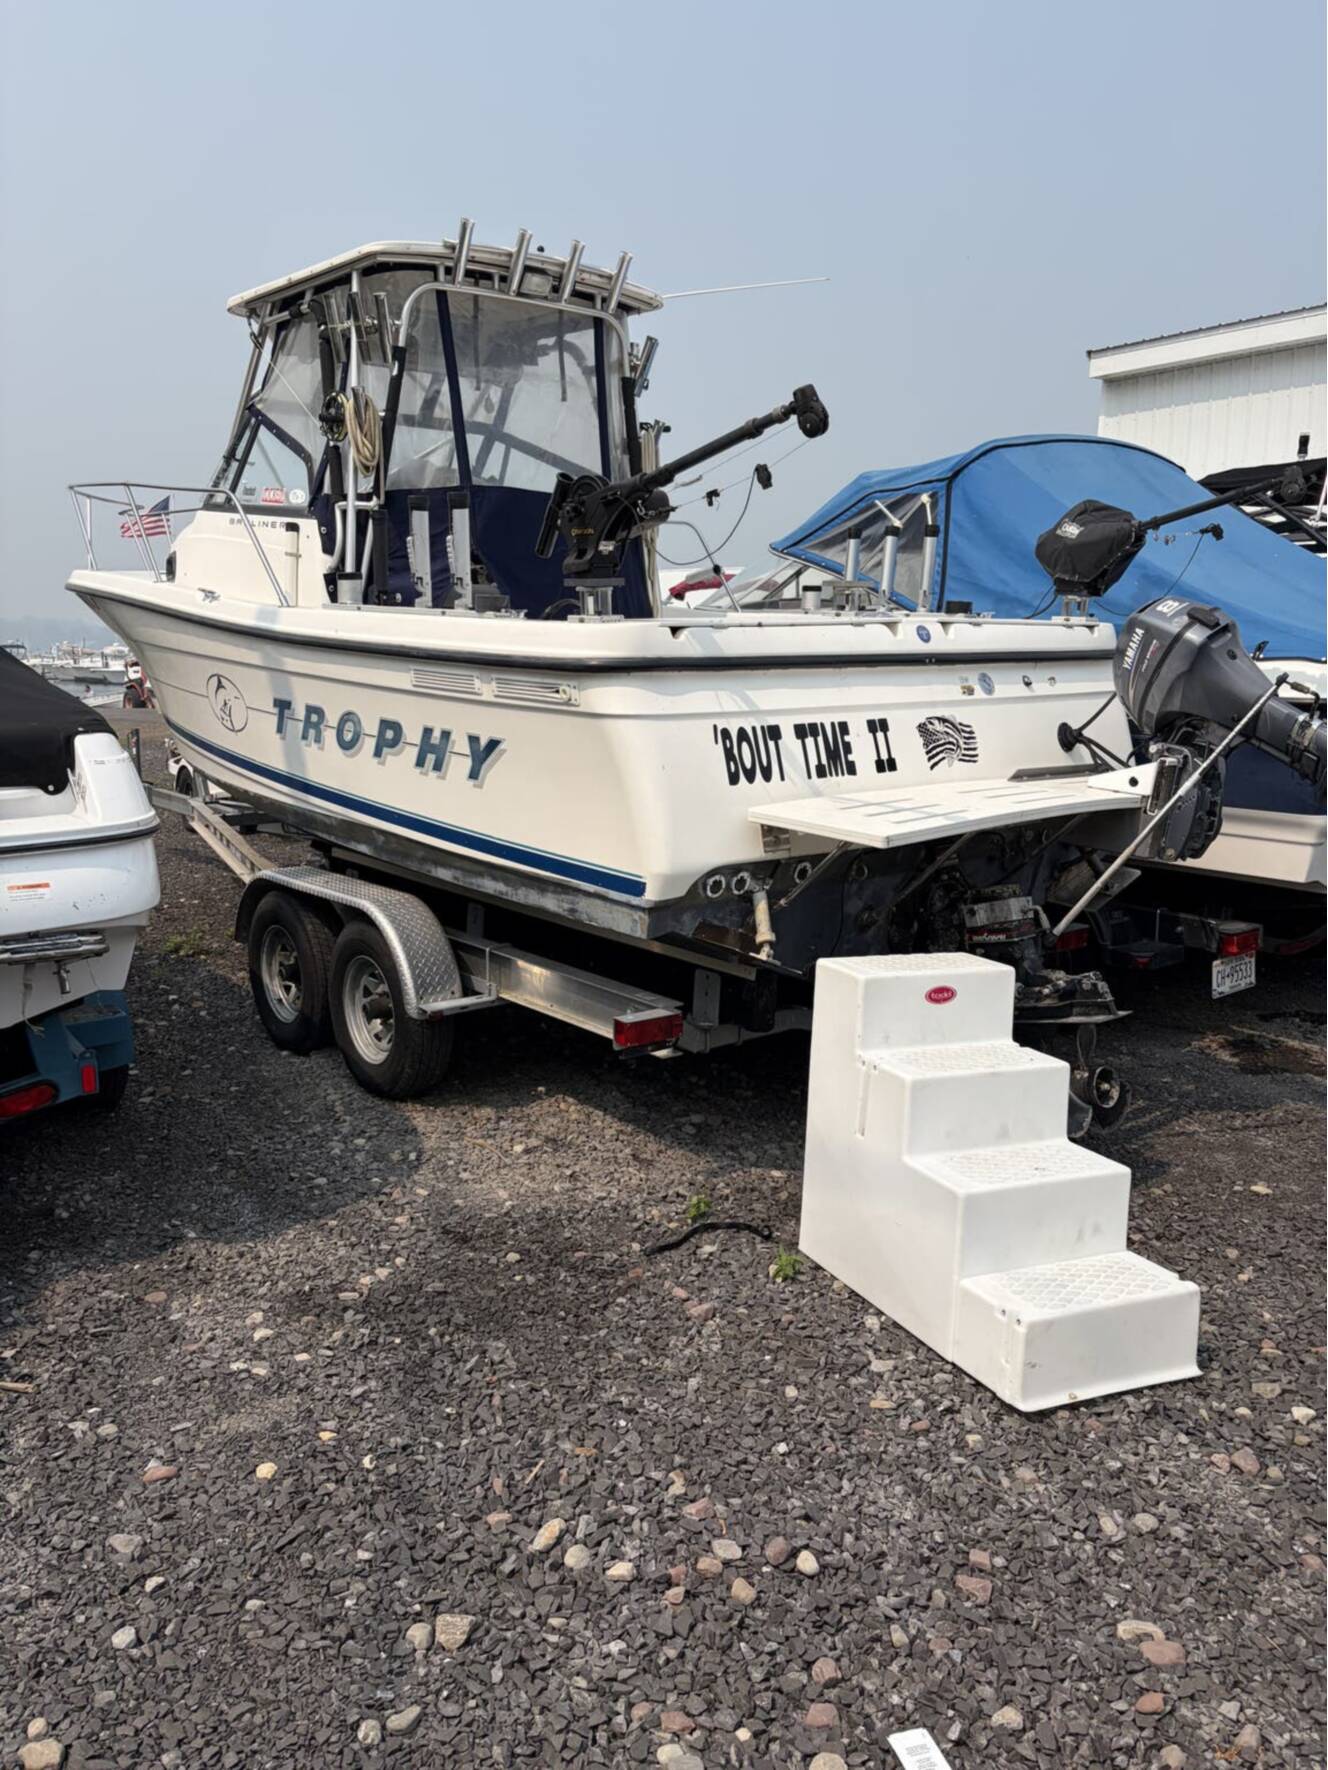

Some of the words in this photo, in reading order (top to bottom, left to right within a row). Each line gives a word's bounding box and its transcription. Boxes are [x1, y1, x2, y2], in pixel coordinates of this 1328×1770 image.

[229, 518, 287, 529] BALINER
[1122, 627, 1145, 670] YAMAHA
[273, 698, 505, 788] TROPHY
[713, 724, 785, 786] 'BOUT
[794, 721, 857, 780] TIME
[866, 718, 898, 773] II
